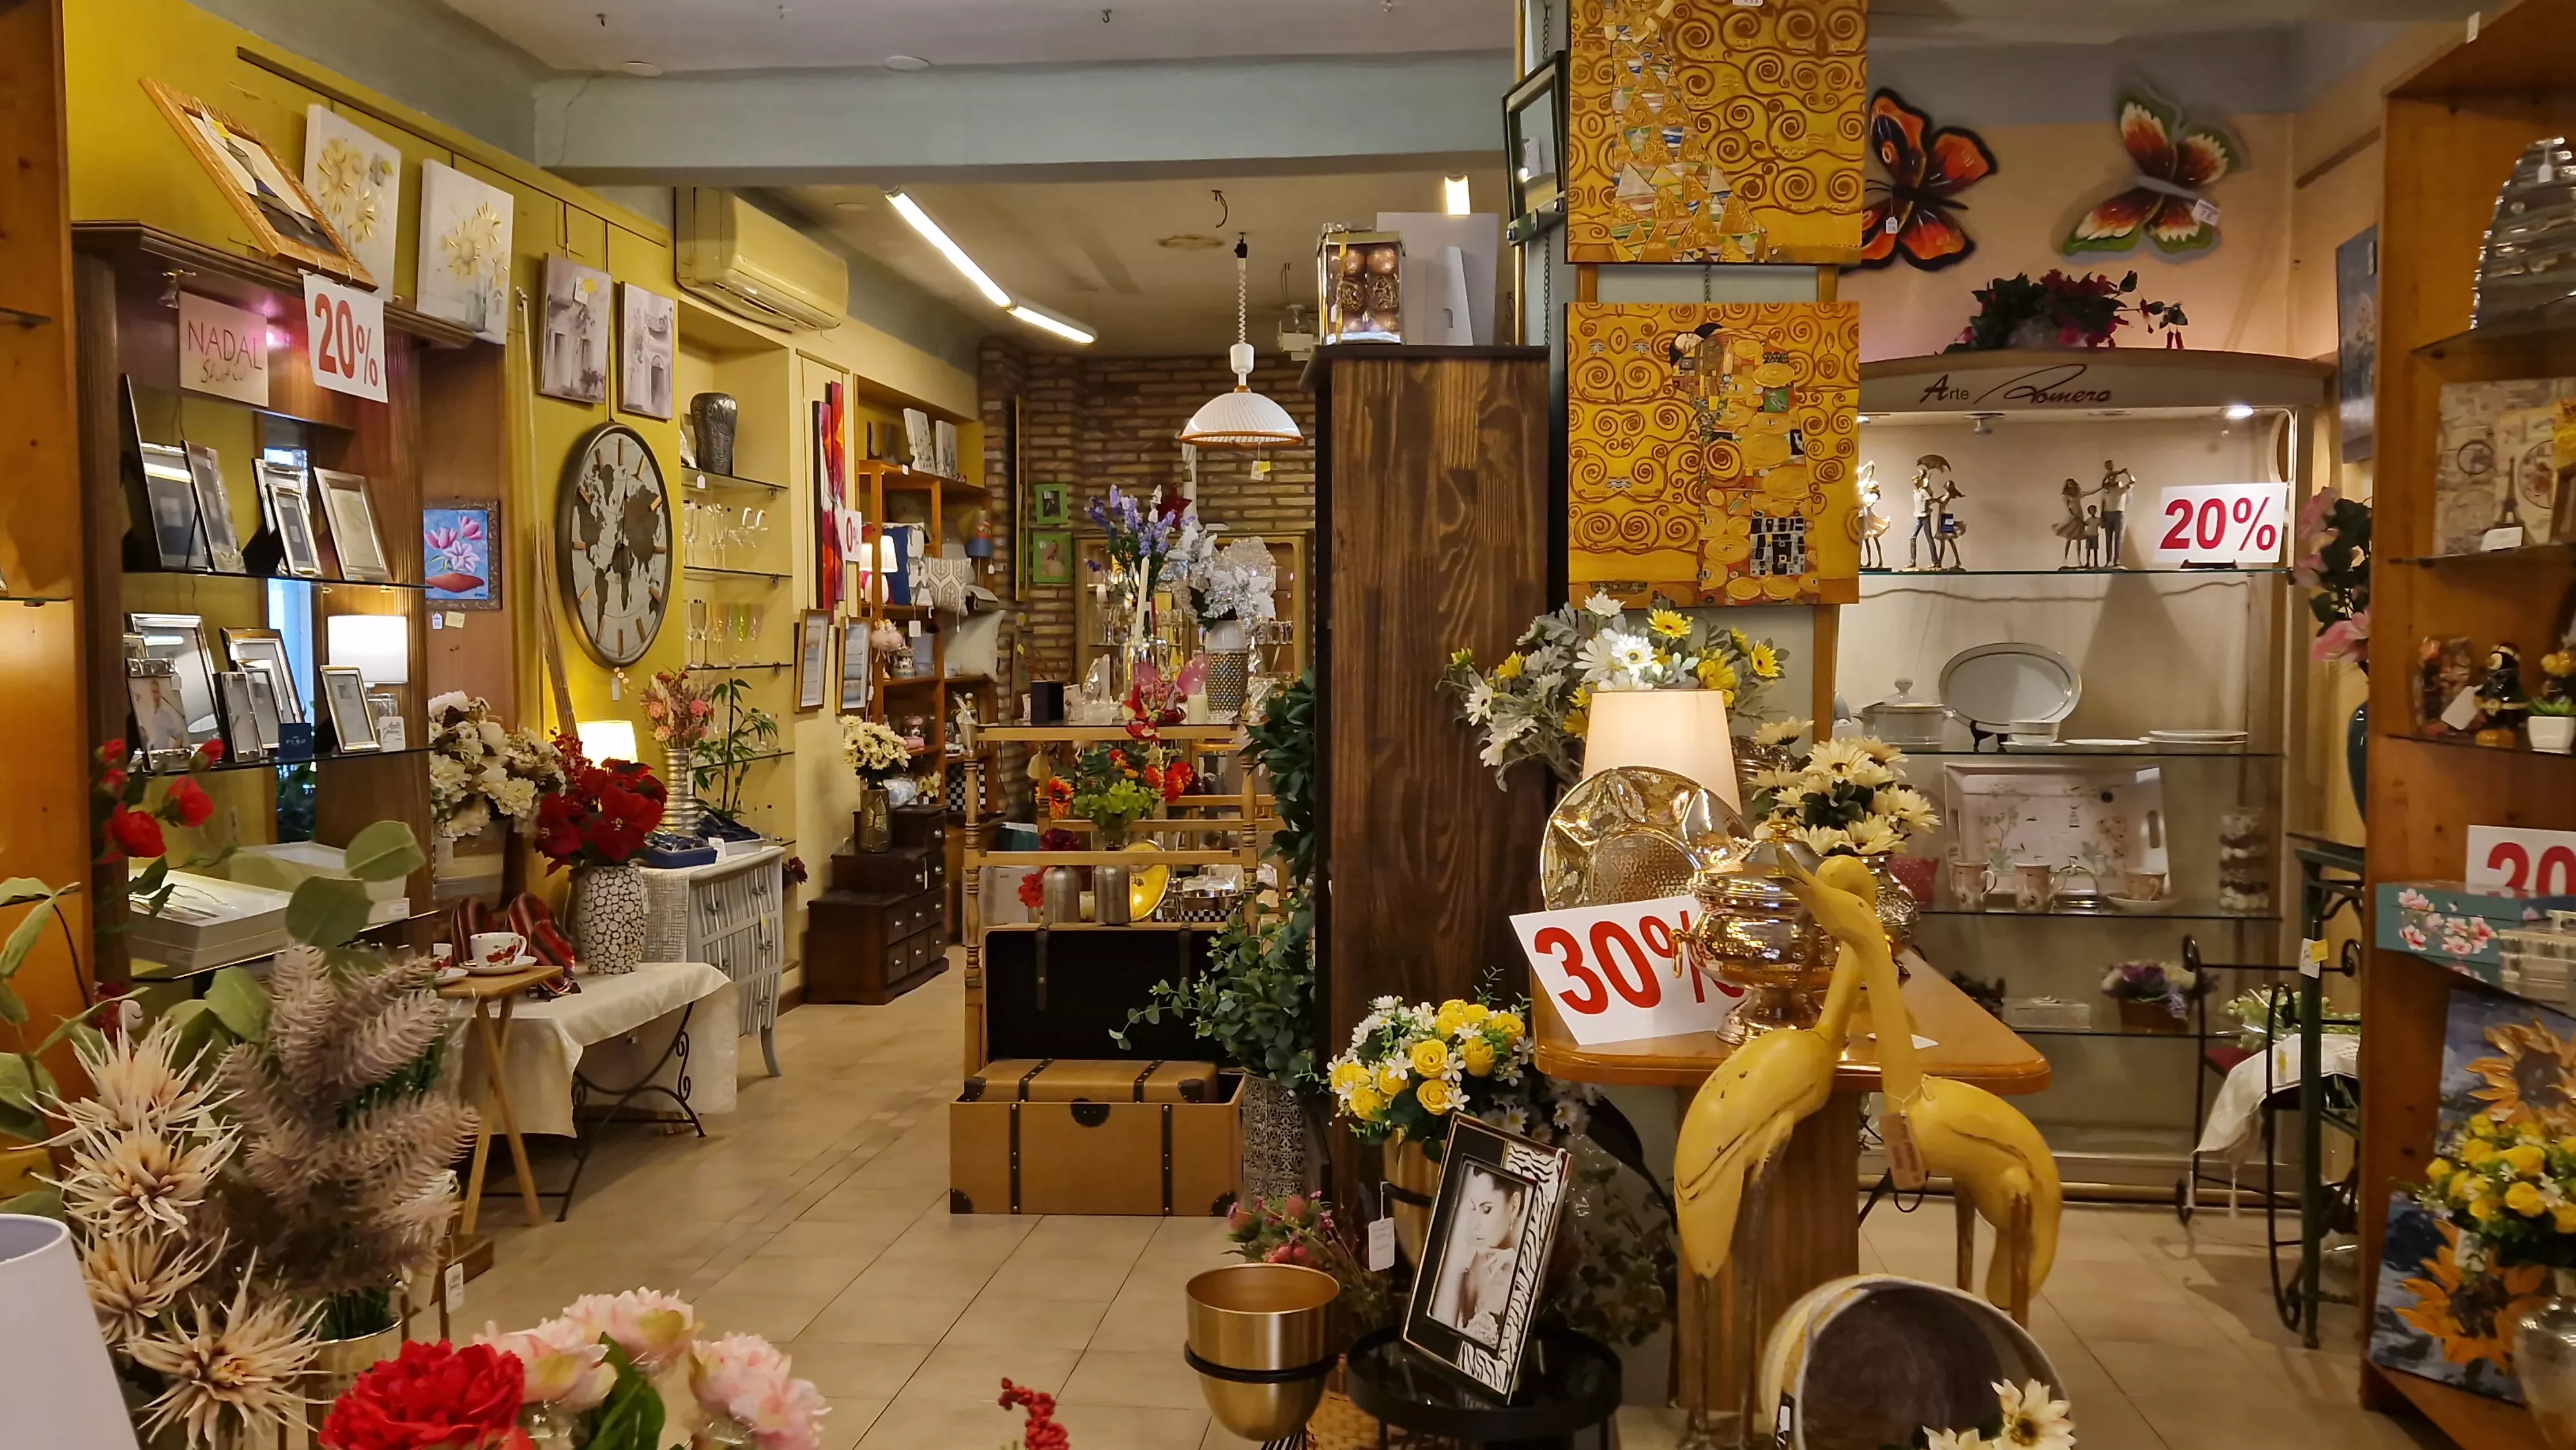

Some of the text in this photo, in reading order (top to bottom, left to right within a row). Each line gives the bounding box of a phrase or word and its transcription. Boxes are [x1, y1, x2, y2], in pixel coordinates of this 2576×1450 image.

[187, 319, 263, 371] NADAL
[314, 292, 378, 387] 20%
[1919, 362, 2111, 404] Arte Romero
[2160, 496, 2277, 551] 20%
